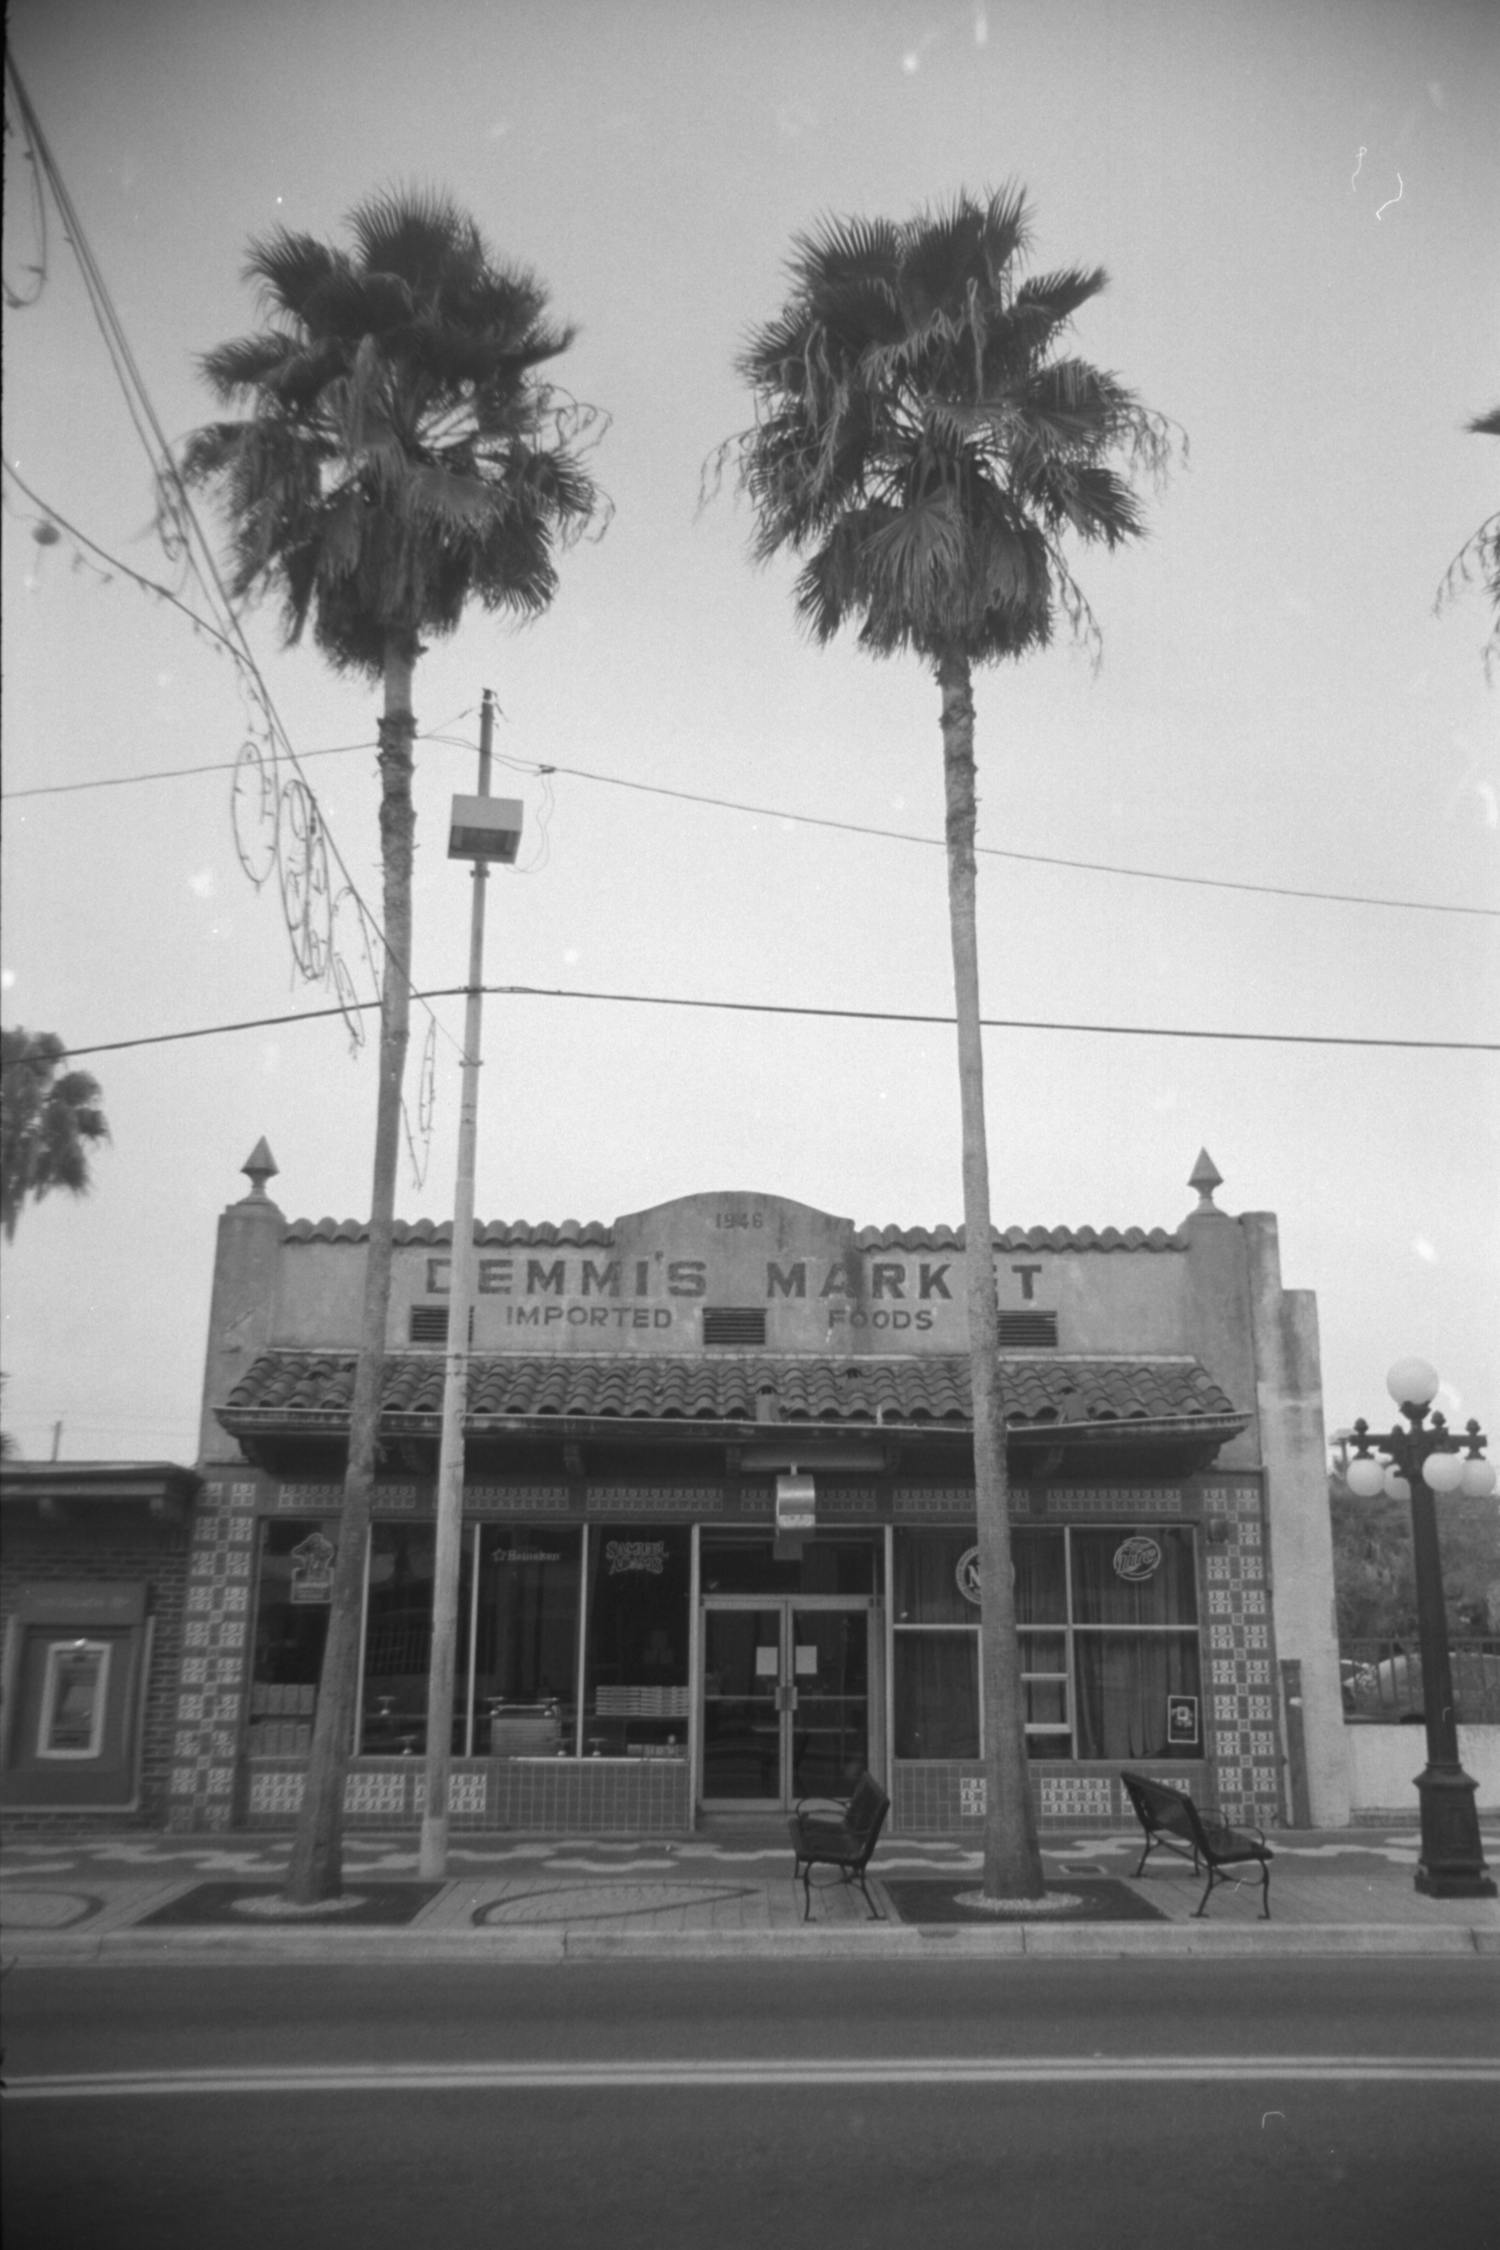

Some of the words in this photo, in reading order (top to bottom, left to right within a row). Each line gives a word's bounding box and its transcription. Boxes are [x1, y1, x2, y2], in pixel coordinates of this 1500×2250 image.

[766, 1261, 1042, 1300] MARKT
[506, 1305, 673, 1329] IMPORTED
[828, 1309, 934, 1331] FOODS
